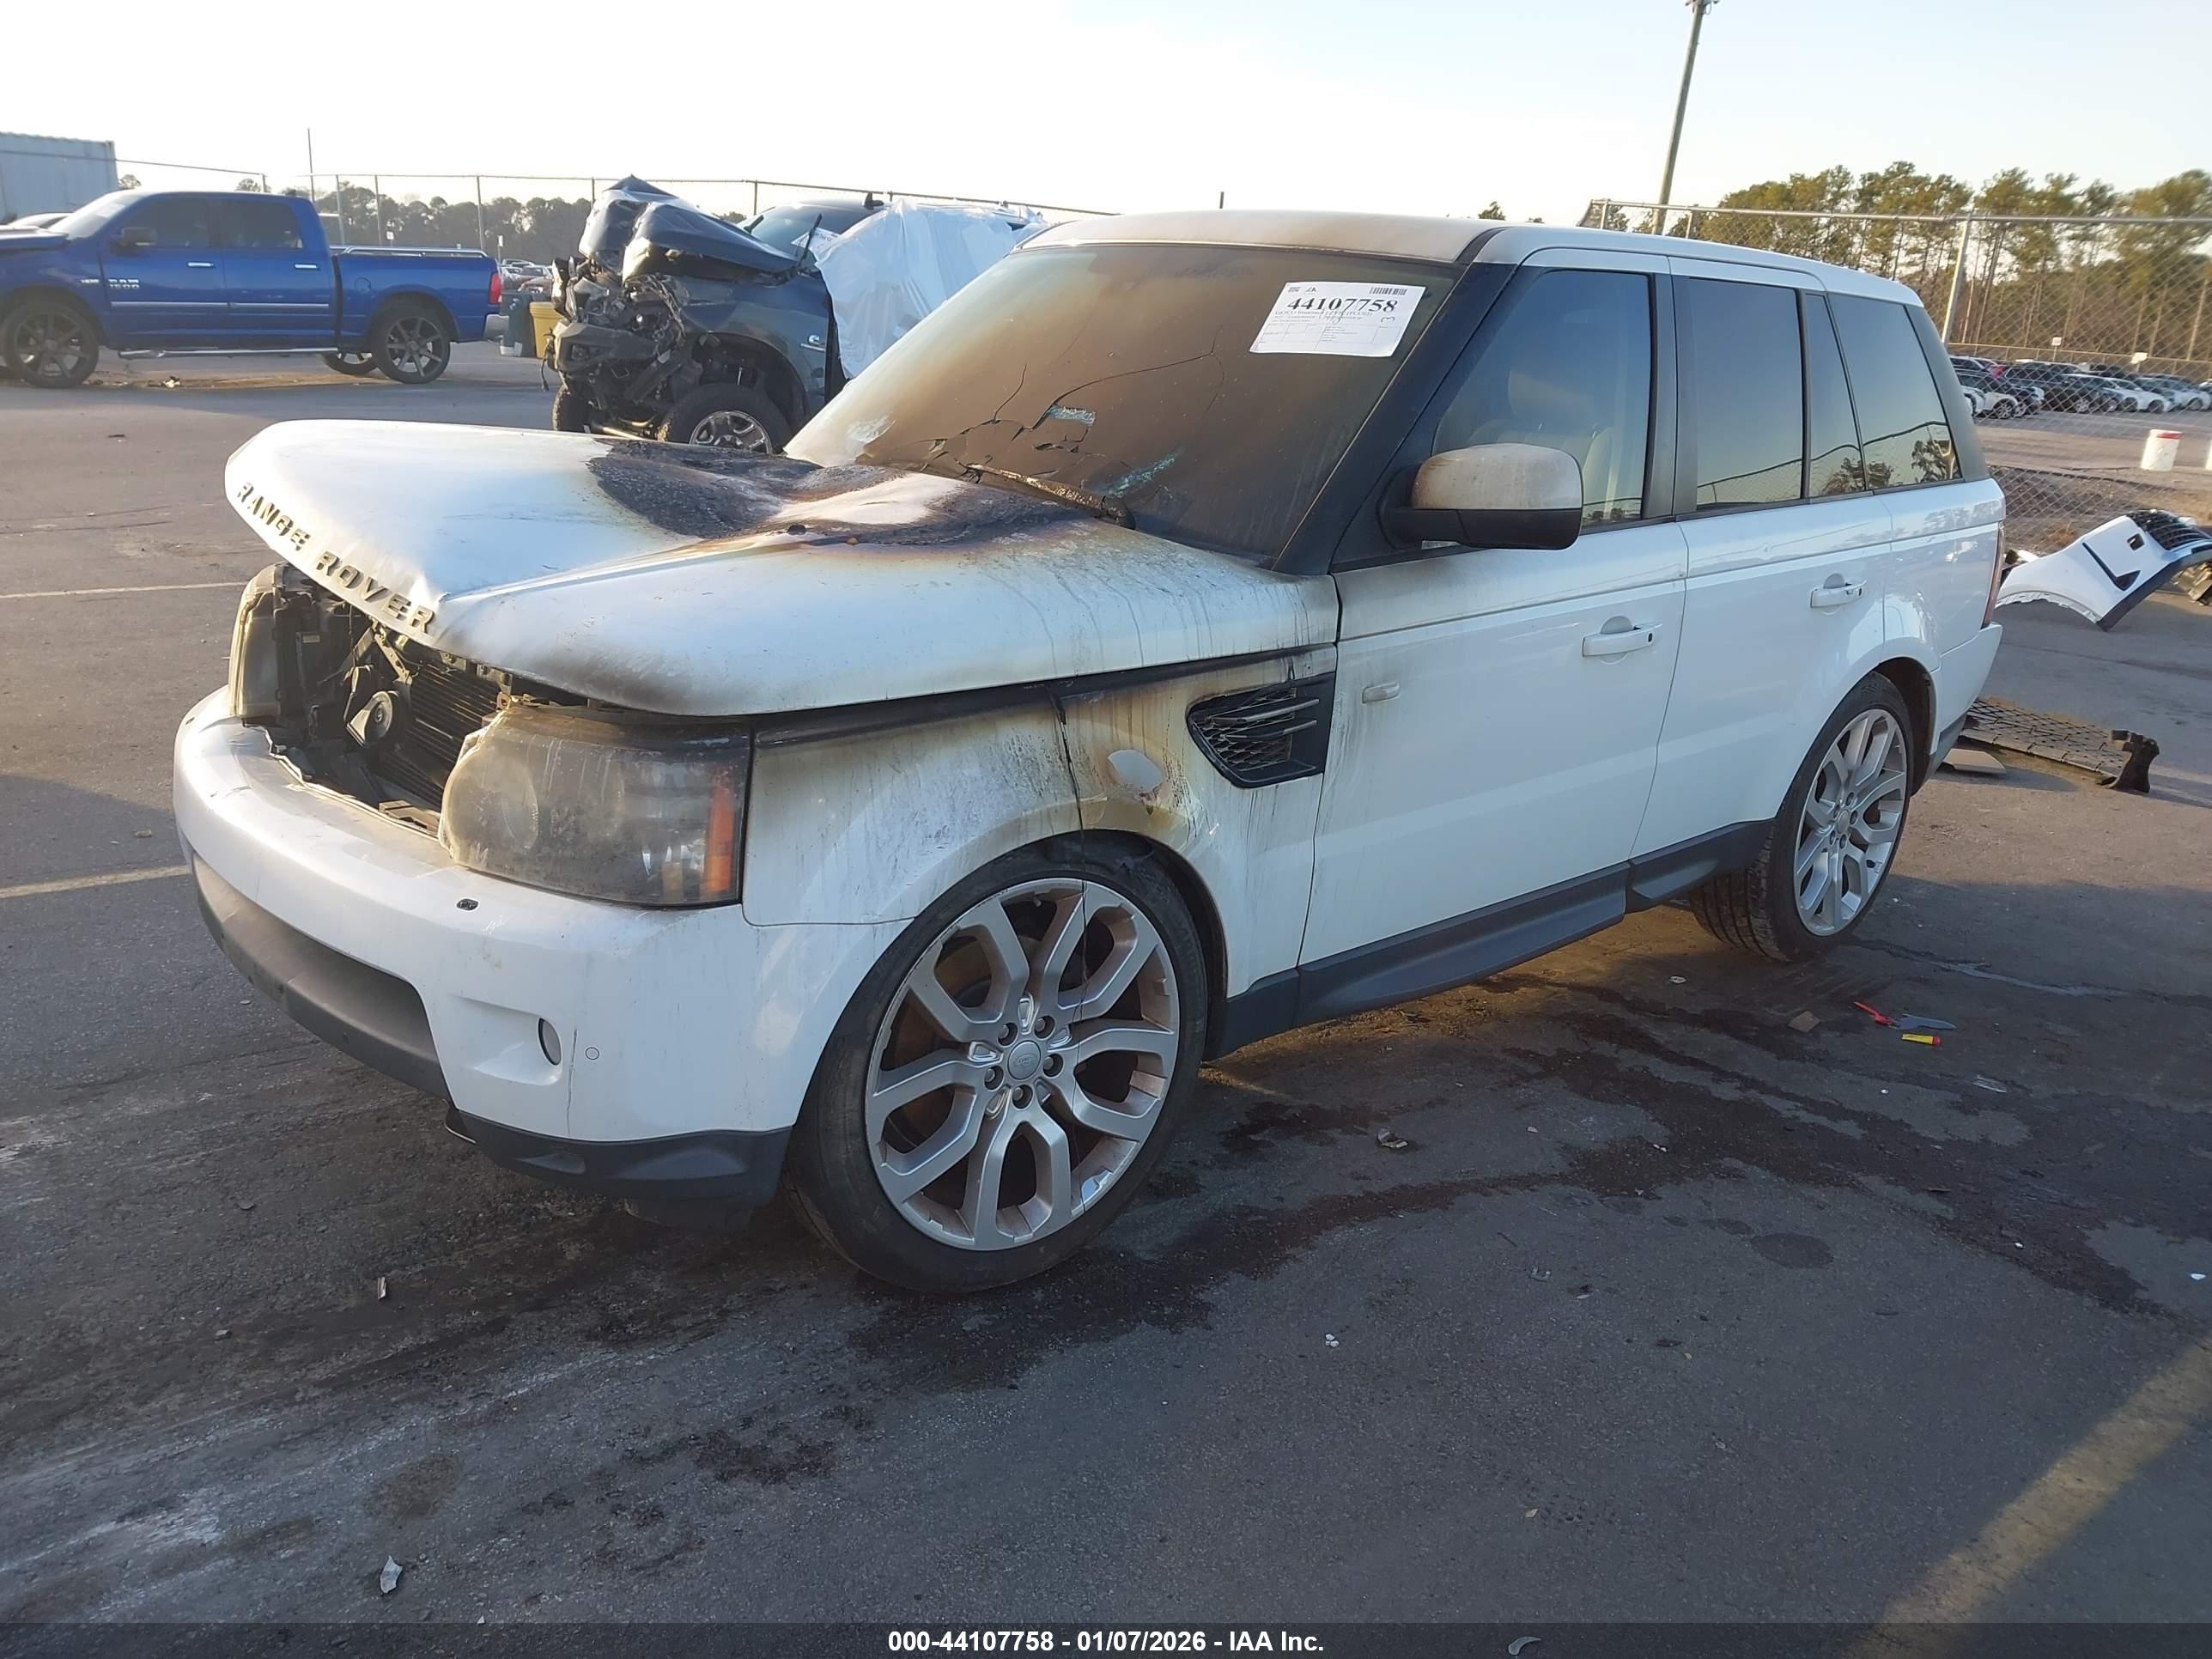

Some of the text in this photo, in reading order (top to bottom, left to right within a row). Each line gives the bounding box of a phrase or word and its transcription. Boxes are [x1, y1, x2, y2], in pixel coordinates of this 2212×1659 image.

[1286, 297, 1398, 313] 44107758
[236, 482, 436, 634] RANGE ROVER
